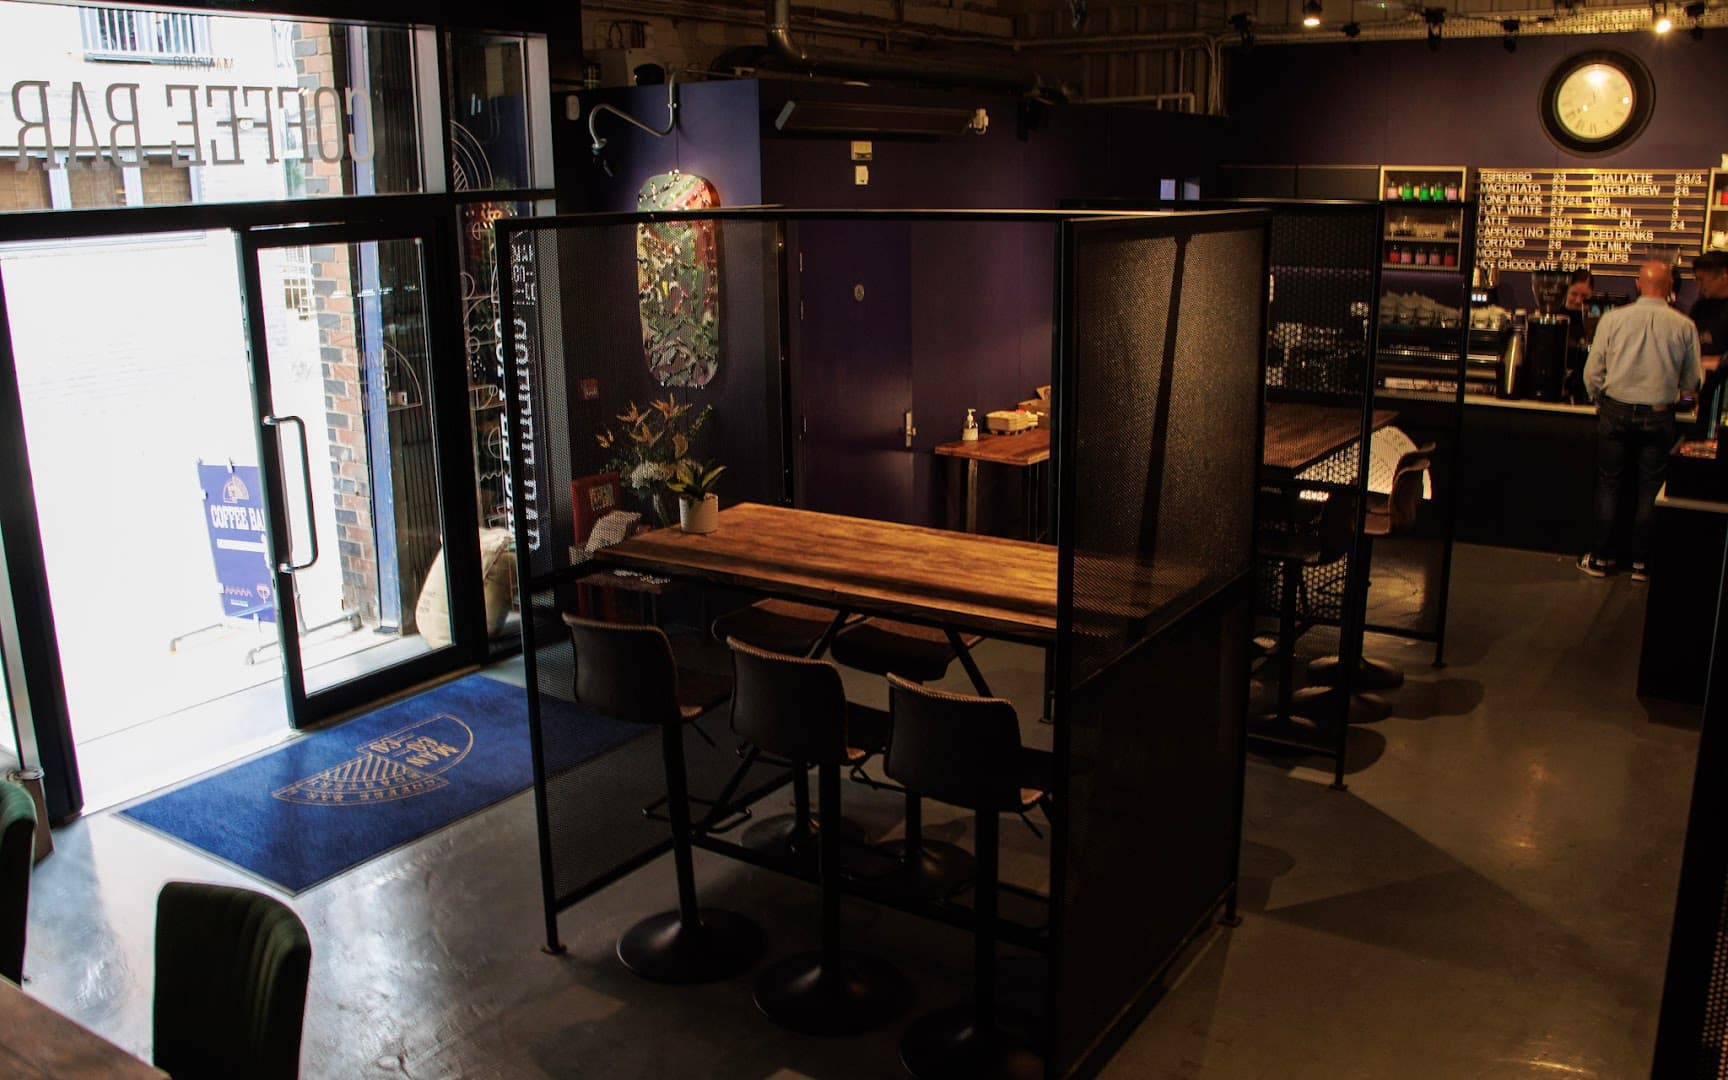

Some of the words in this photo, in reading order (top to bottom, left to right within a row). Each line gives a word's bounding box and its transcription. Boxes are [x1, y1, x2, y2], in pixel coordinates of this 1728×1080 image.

[1480, 172, 1532, 182] ESPRESSO
[1480, 183, 1541, 193] MACCHIATO
[1592, 184, 1626, 195] BATCH
[1628, 185, 1661, 196] BREW
[1479, 194, 1506, 204] LONG
[1510, 195, 1543, 205] BLACK
[1479, 205, 1503, 215] FLAT
[1507, 205, 1543, 216] WHITE
[1621, 207, 1631, 217] IN
[1478, 215, 1509, 225] LATTE
[1620, 218, 1643, 229] OUT
[1477, 227, 1544, 238] CAPPUCCINO
[1589, 230, 1613, 240] ICED
[1615, 230, 1654, 241] DRINKS
[1477, 238, 1525, 248] CORTADO
[1607, 241, 1632, 252] MILK
[1476, 248, 1512, 258] MOCHA
[1587, 252, 1629, 263] SYRUPS
[1498, 259, 1558, 271] CHOCOLATE
[210, 505, 248, 531] COFFEE
